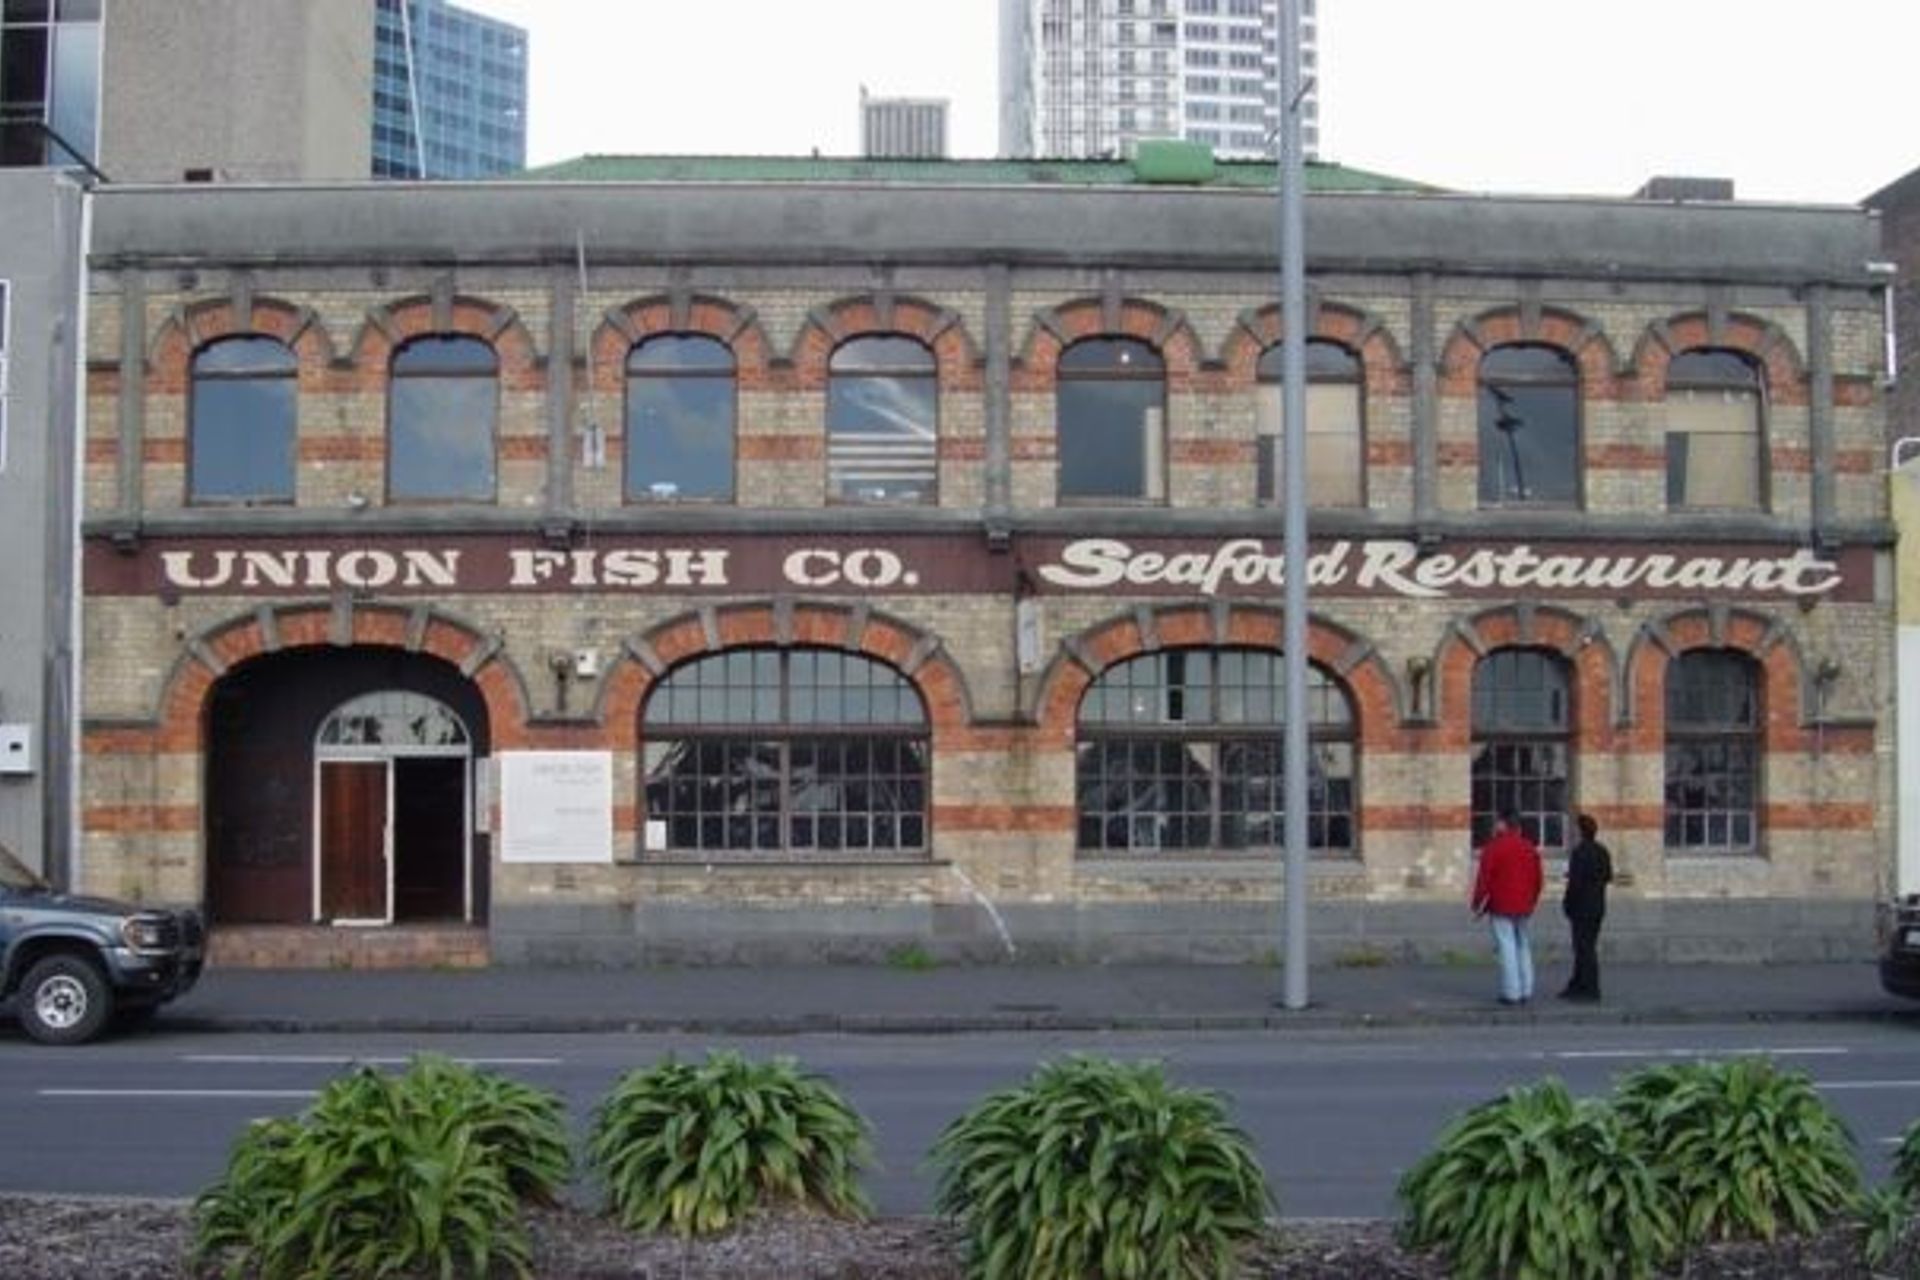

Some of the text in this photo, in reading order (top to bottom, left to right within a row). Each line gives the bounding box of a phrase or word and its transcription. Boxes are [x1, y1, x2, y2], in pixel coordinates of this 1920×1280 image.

[160, 549, 920, 587] UNION FISH CO.
[1355, 540, 1842, 597] Restaurant
